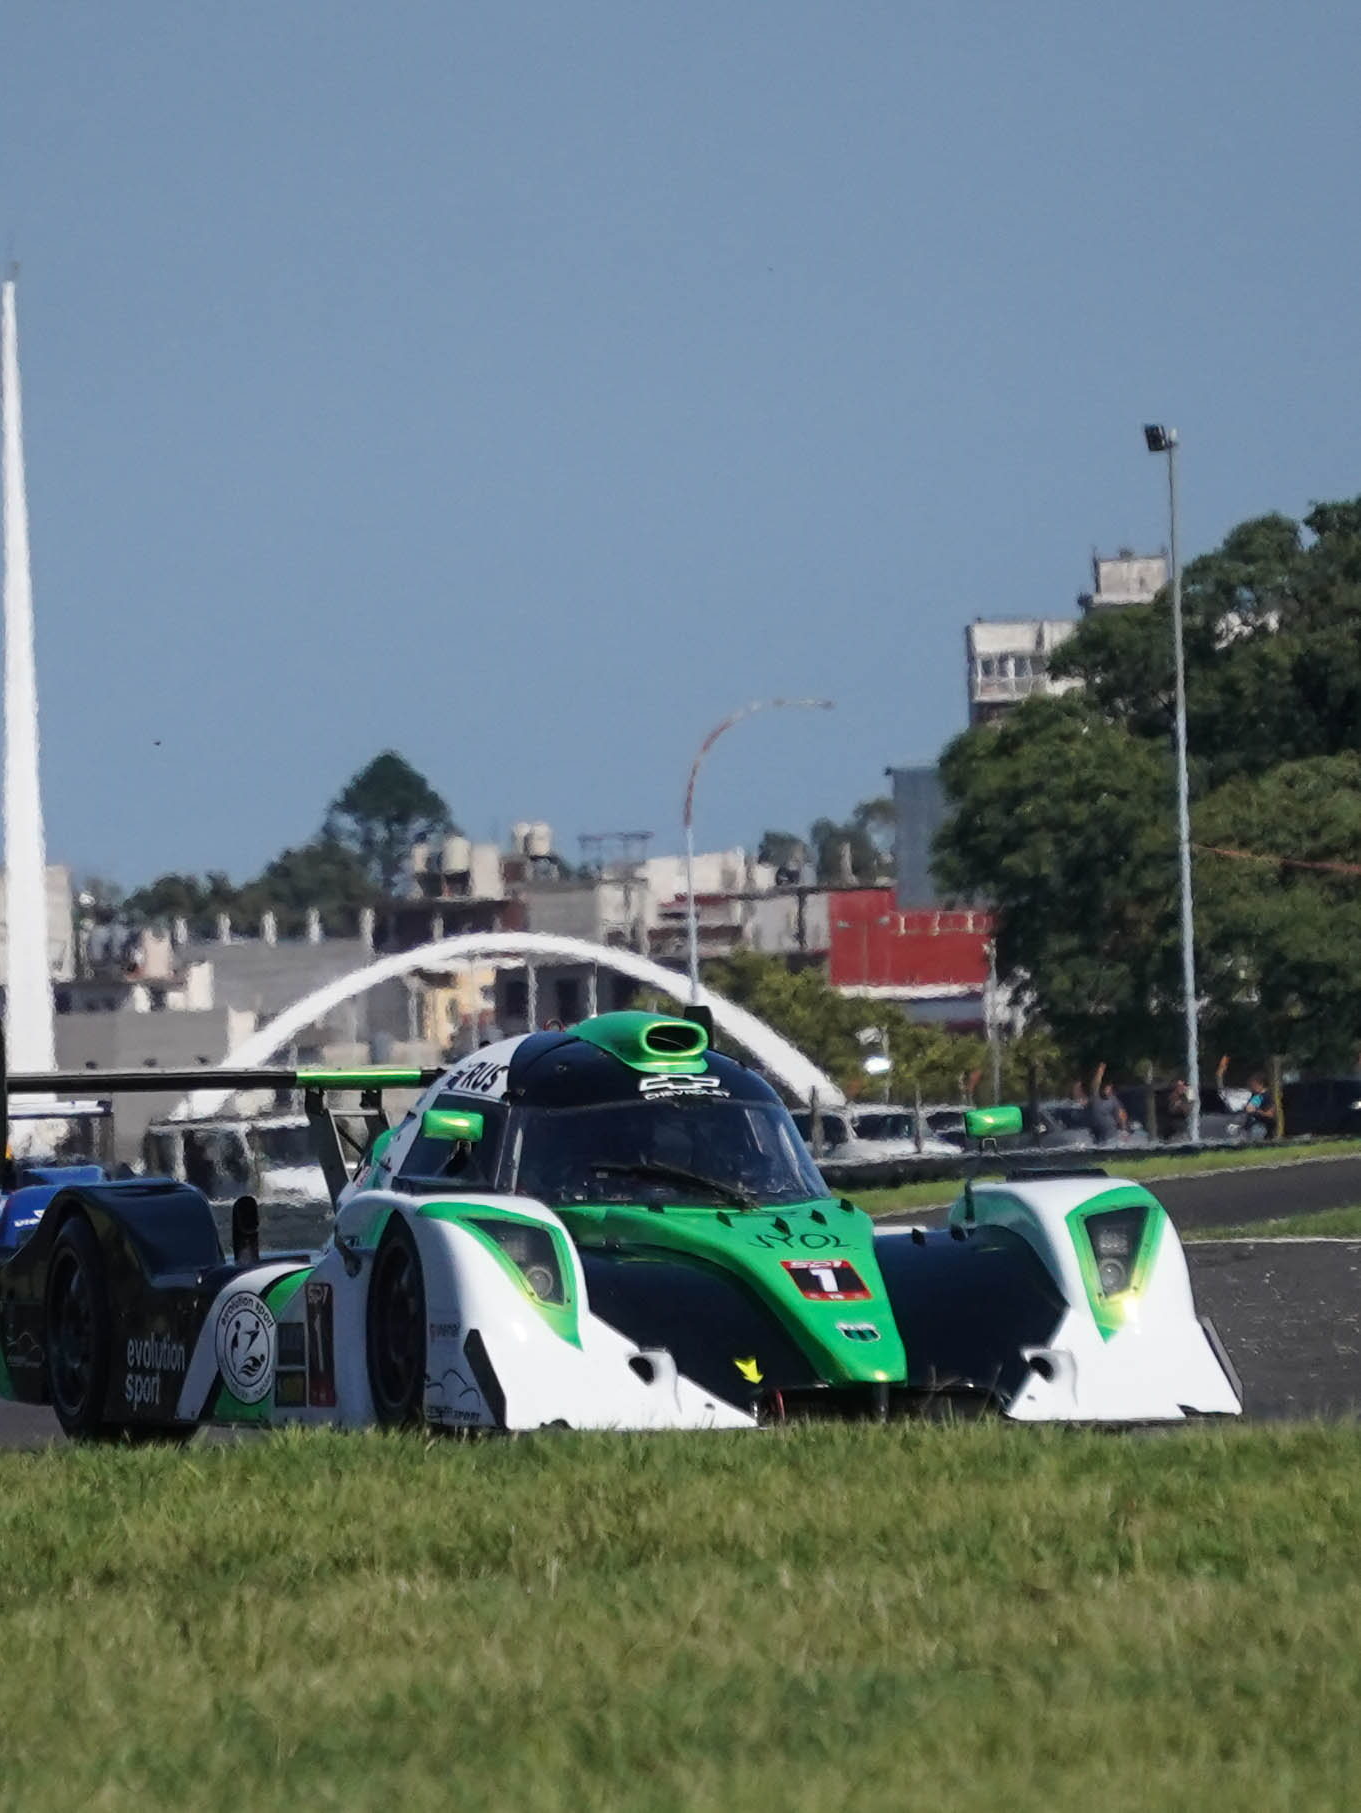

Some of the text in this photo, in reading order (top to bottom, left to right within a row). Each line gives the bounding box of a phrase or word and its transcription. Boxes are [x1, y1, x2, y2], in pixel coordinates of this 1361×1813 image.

[808, 1268, 840, 1293] 1
[126, 1331, 185, 1371] evolution
[125, 1371, 160, 1411] sport
